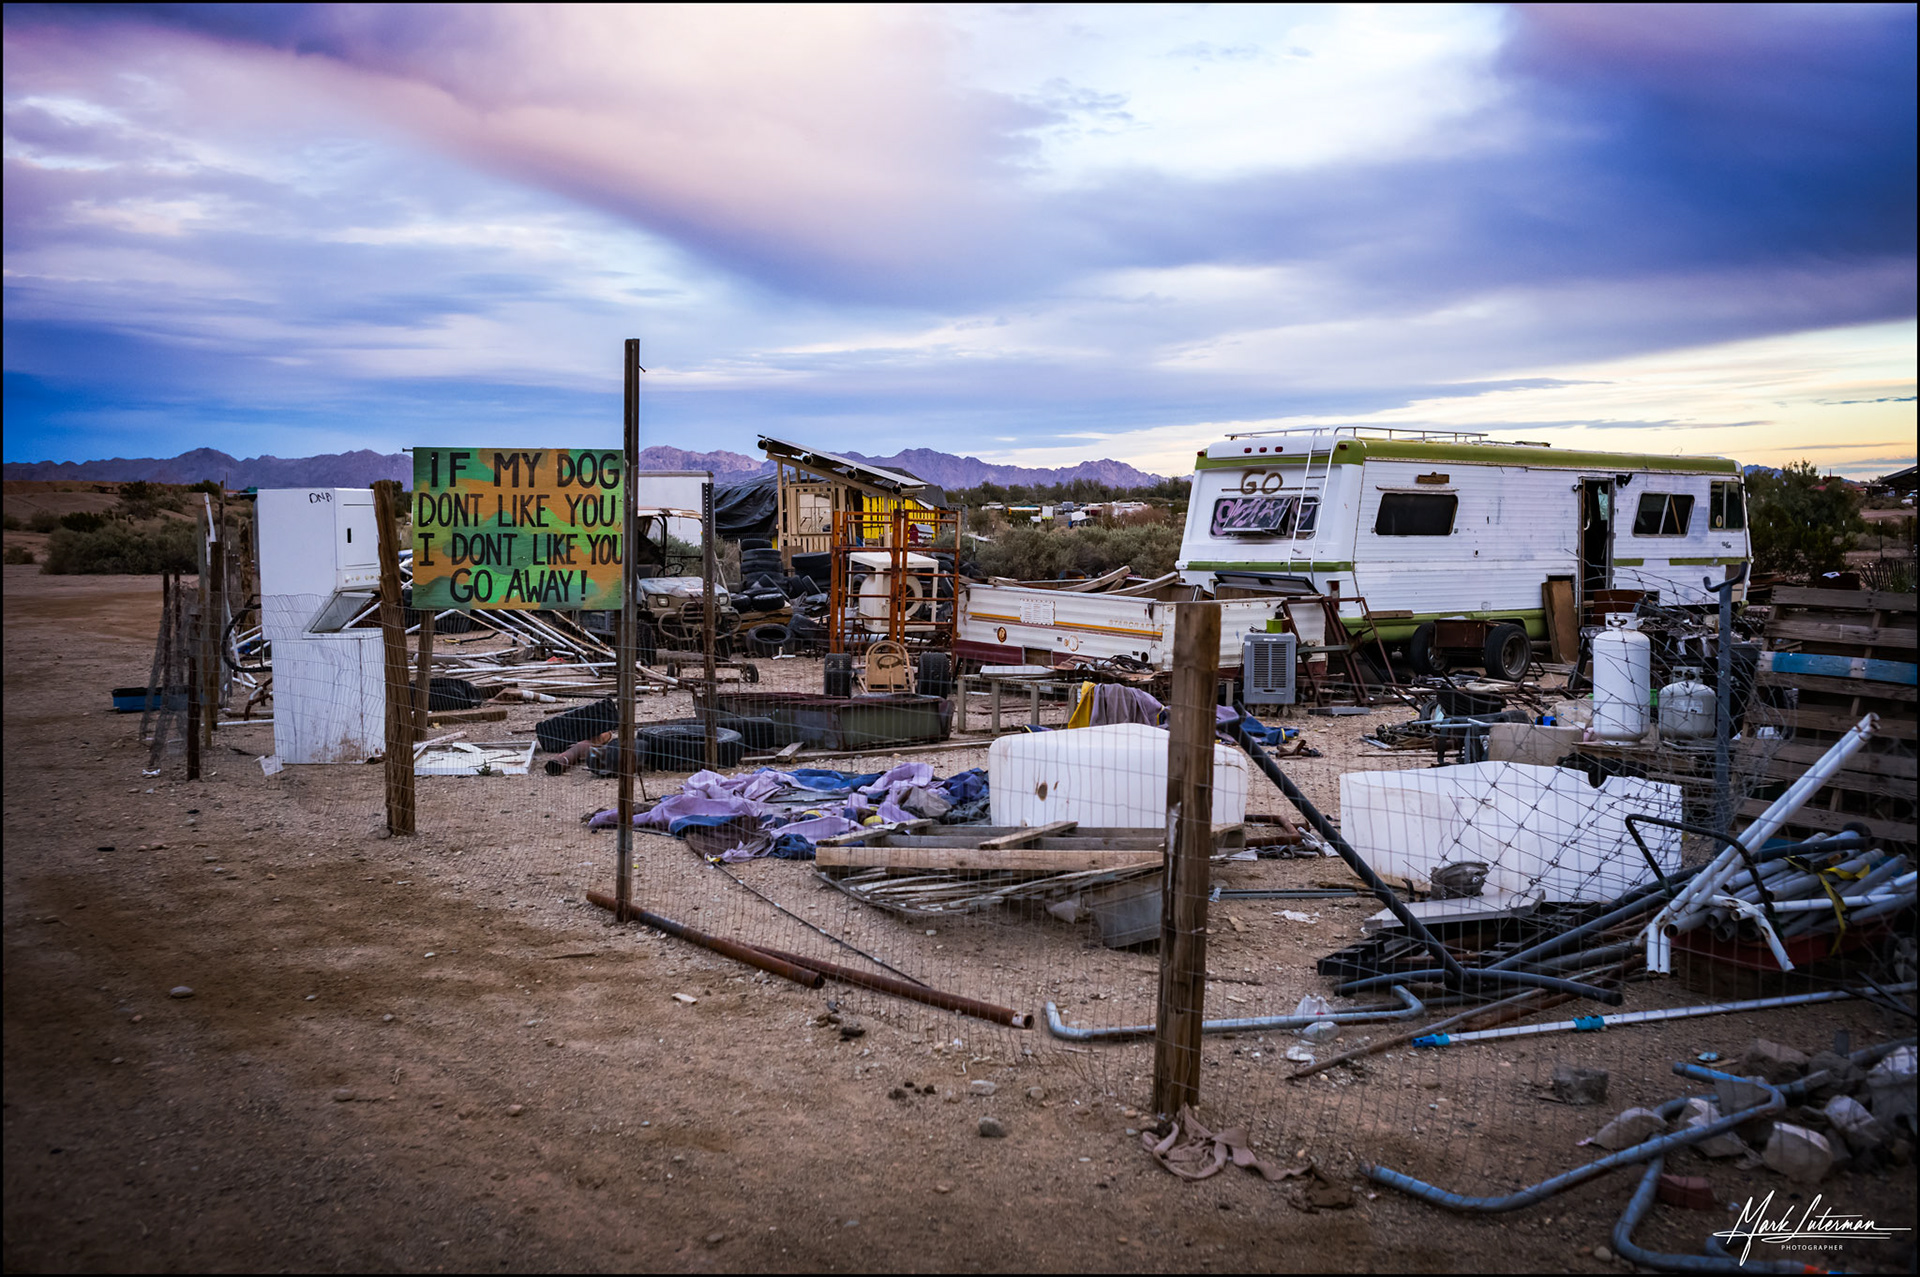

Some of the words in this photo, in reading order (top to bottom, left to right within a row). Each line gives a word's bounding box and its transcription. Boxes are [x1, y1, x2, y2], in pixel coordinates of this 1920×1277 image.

[430, 452, 470, 488] IF
[493, 452, 542, 488] MY
[557, 453, 620, 490] DOG
[1240, 470, 1284, 495] GO
[418, 492, 484, 528] DONT
[498, 494, 550, 528] LIKE
[418, 532, 435, 567] I
[451, 533, 518, 566] DONT
[532, 533, 578, 566] LIKE
[587, 533, 624, 566] YOU
[450, 567, 493, 603] GO
[504, 568, 588, 603] AWAY!
